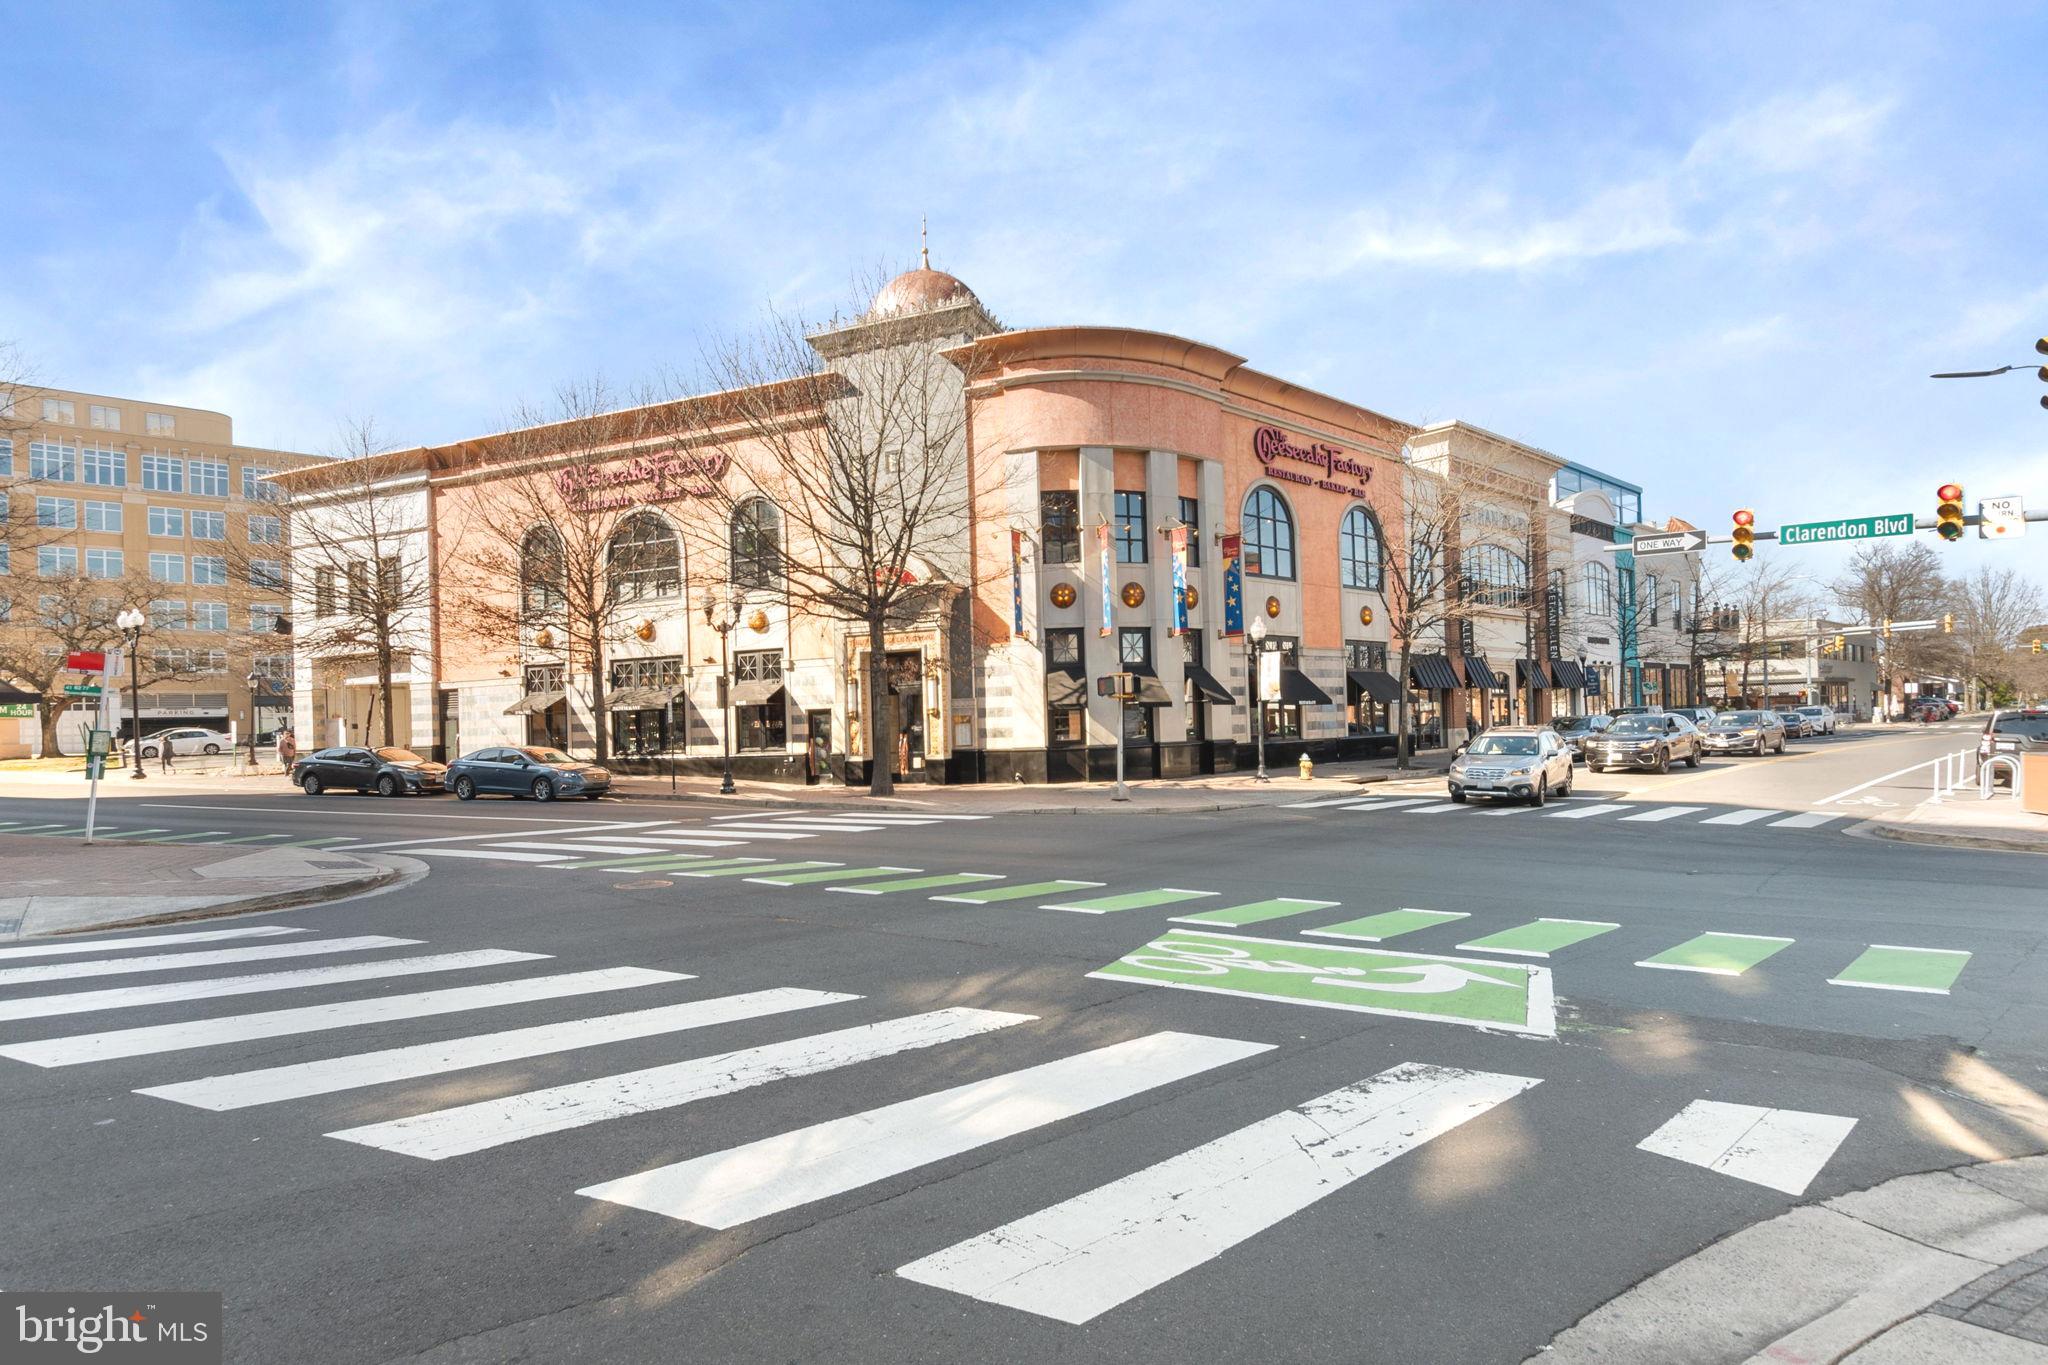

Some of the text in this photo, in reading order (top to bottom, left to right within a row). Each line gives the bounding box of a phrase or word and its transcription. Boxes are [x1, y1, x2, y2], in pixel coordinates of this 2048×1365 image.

[1254, 426, 1374, 486] Cheesecake Factory
[1992, 500, 2010, 509] NO
[1786, 517, 1907, 542] Clarendon Blvd
[1640, 538, 1683, 550] ONE WAY
[1462, 619, 1472, 654] ALLEN
[10, 709, 33, 717] HOUR
